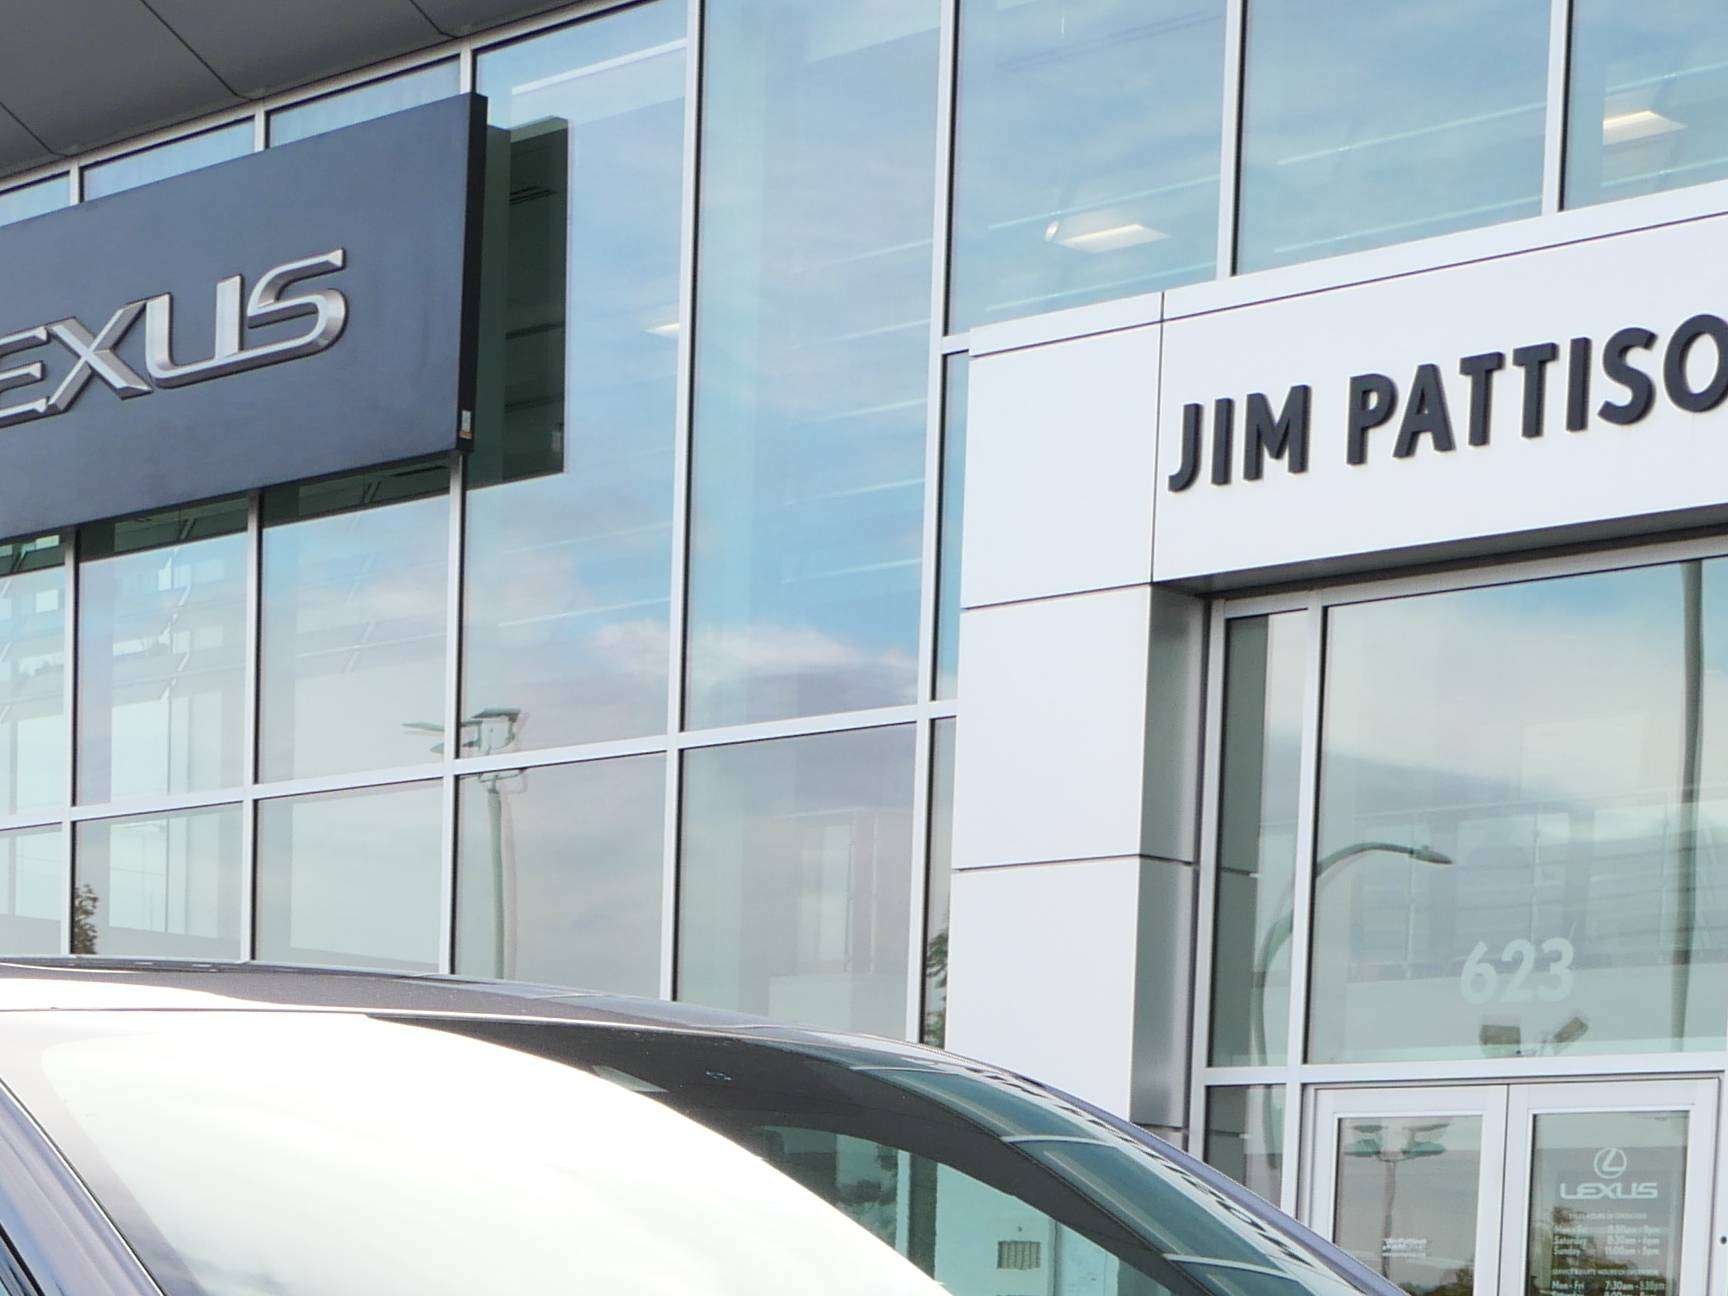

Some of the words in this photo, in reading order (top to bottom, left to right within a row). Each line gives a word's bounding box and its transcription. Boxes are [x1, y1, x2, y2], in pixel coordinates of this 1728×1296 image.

[1168, 384, 1312, 493] JIM
[1460, 936, 1574, 1003] 623
[1559, 1182, 1659, 1200] LEXUS
